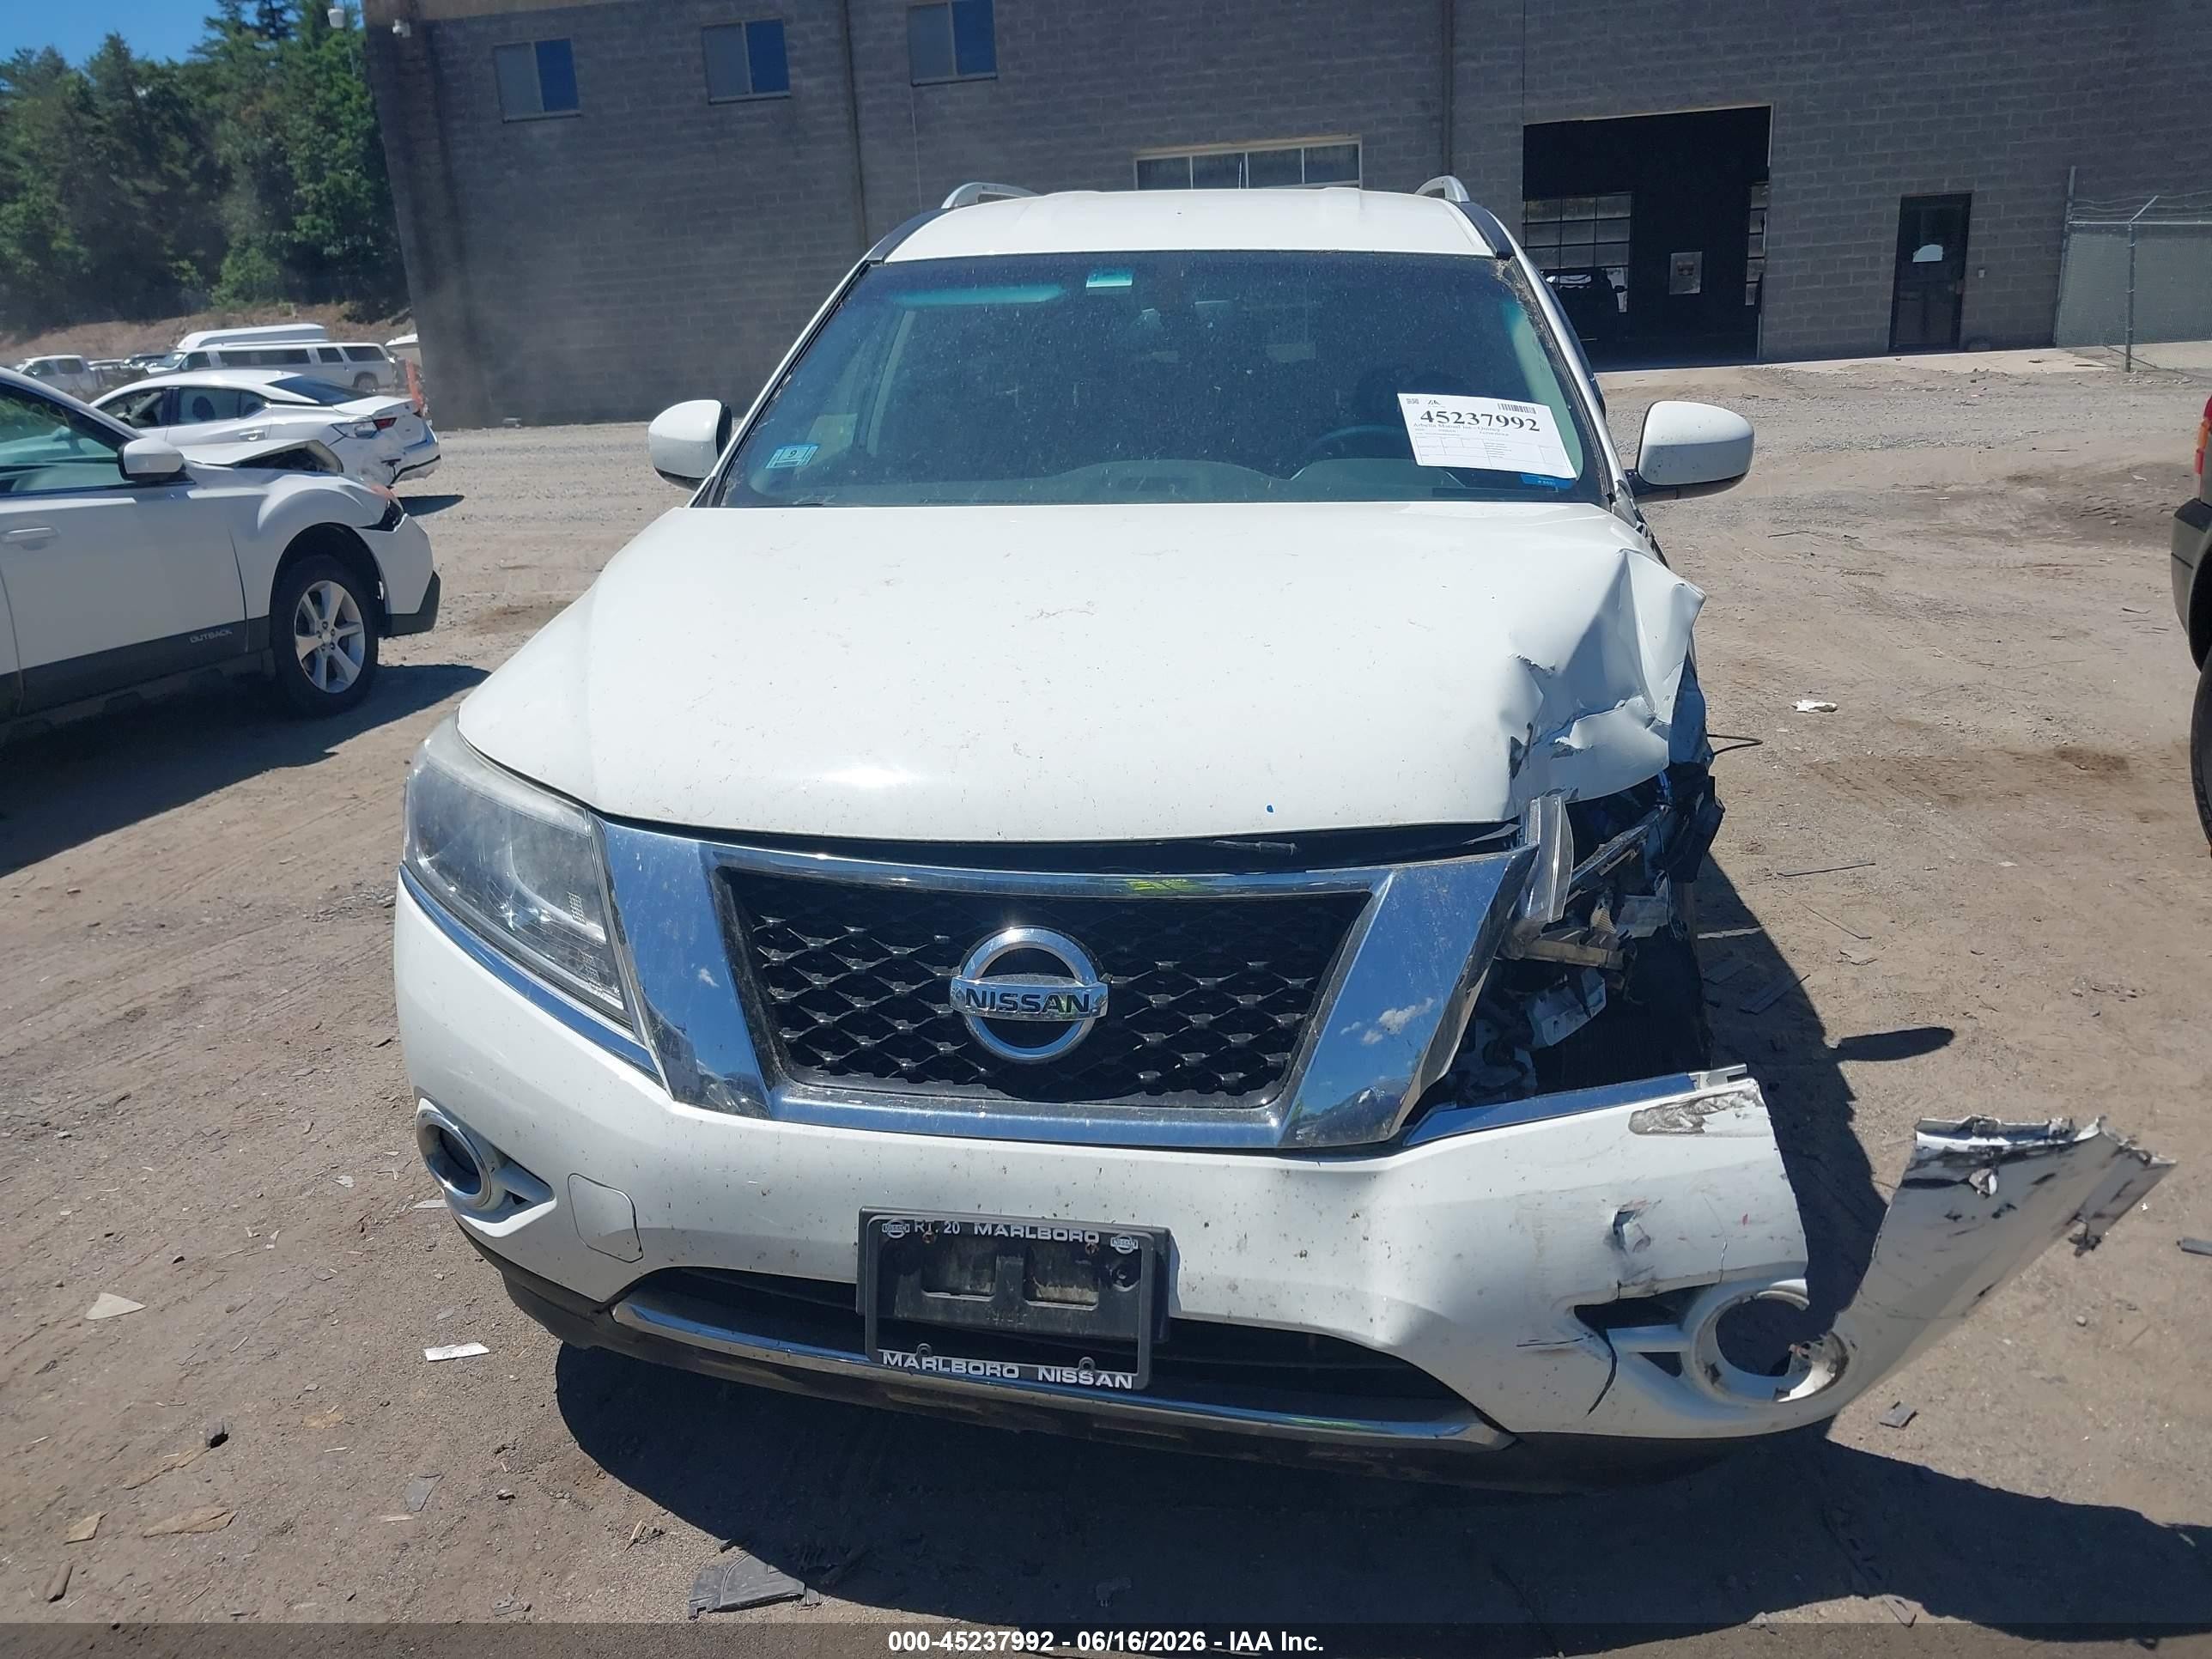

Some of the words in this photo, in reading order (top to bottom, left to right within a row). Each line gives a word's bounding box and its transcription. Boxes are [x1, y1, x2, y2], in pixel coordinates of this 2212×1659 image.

[1420, 410, 1540, 431] 45237992
[189, 630, 233, 643] OUTBACK
[966, 988, 1090, 1013] NISSAN
[944, 1221, 961, 1234] 20
[974, 1223, 1100, 1243] MARLBORO
[883, 1352, 1019, 1378] MARLBORO
[1038, 1367, 1133, 1389] NISSAN
